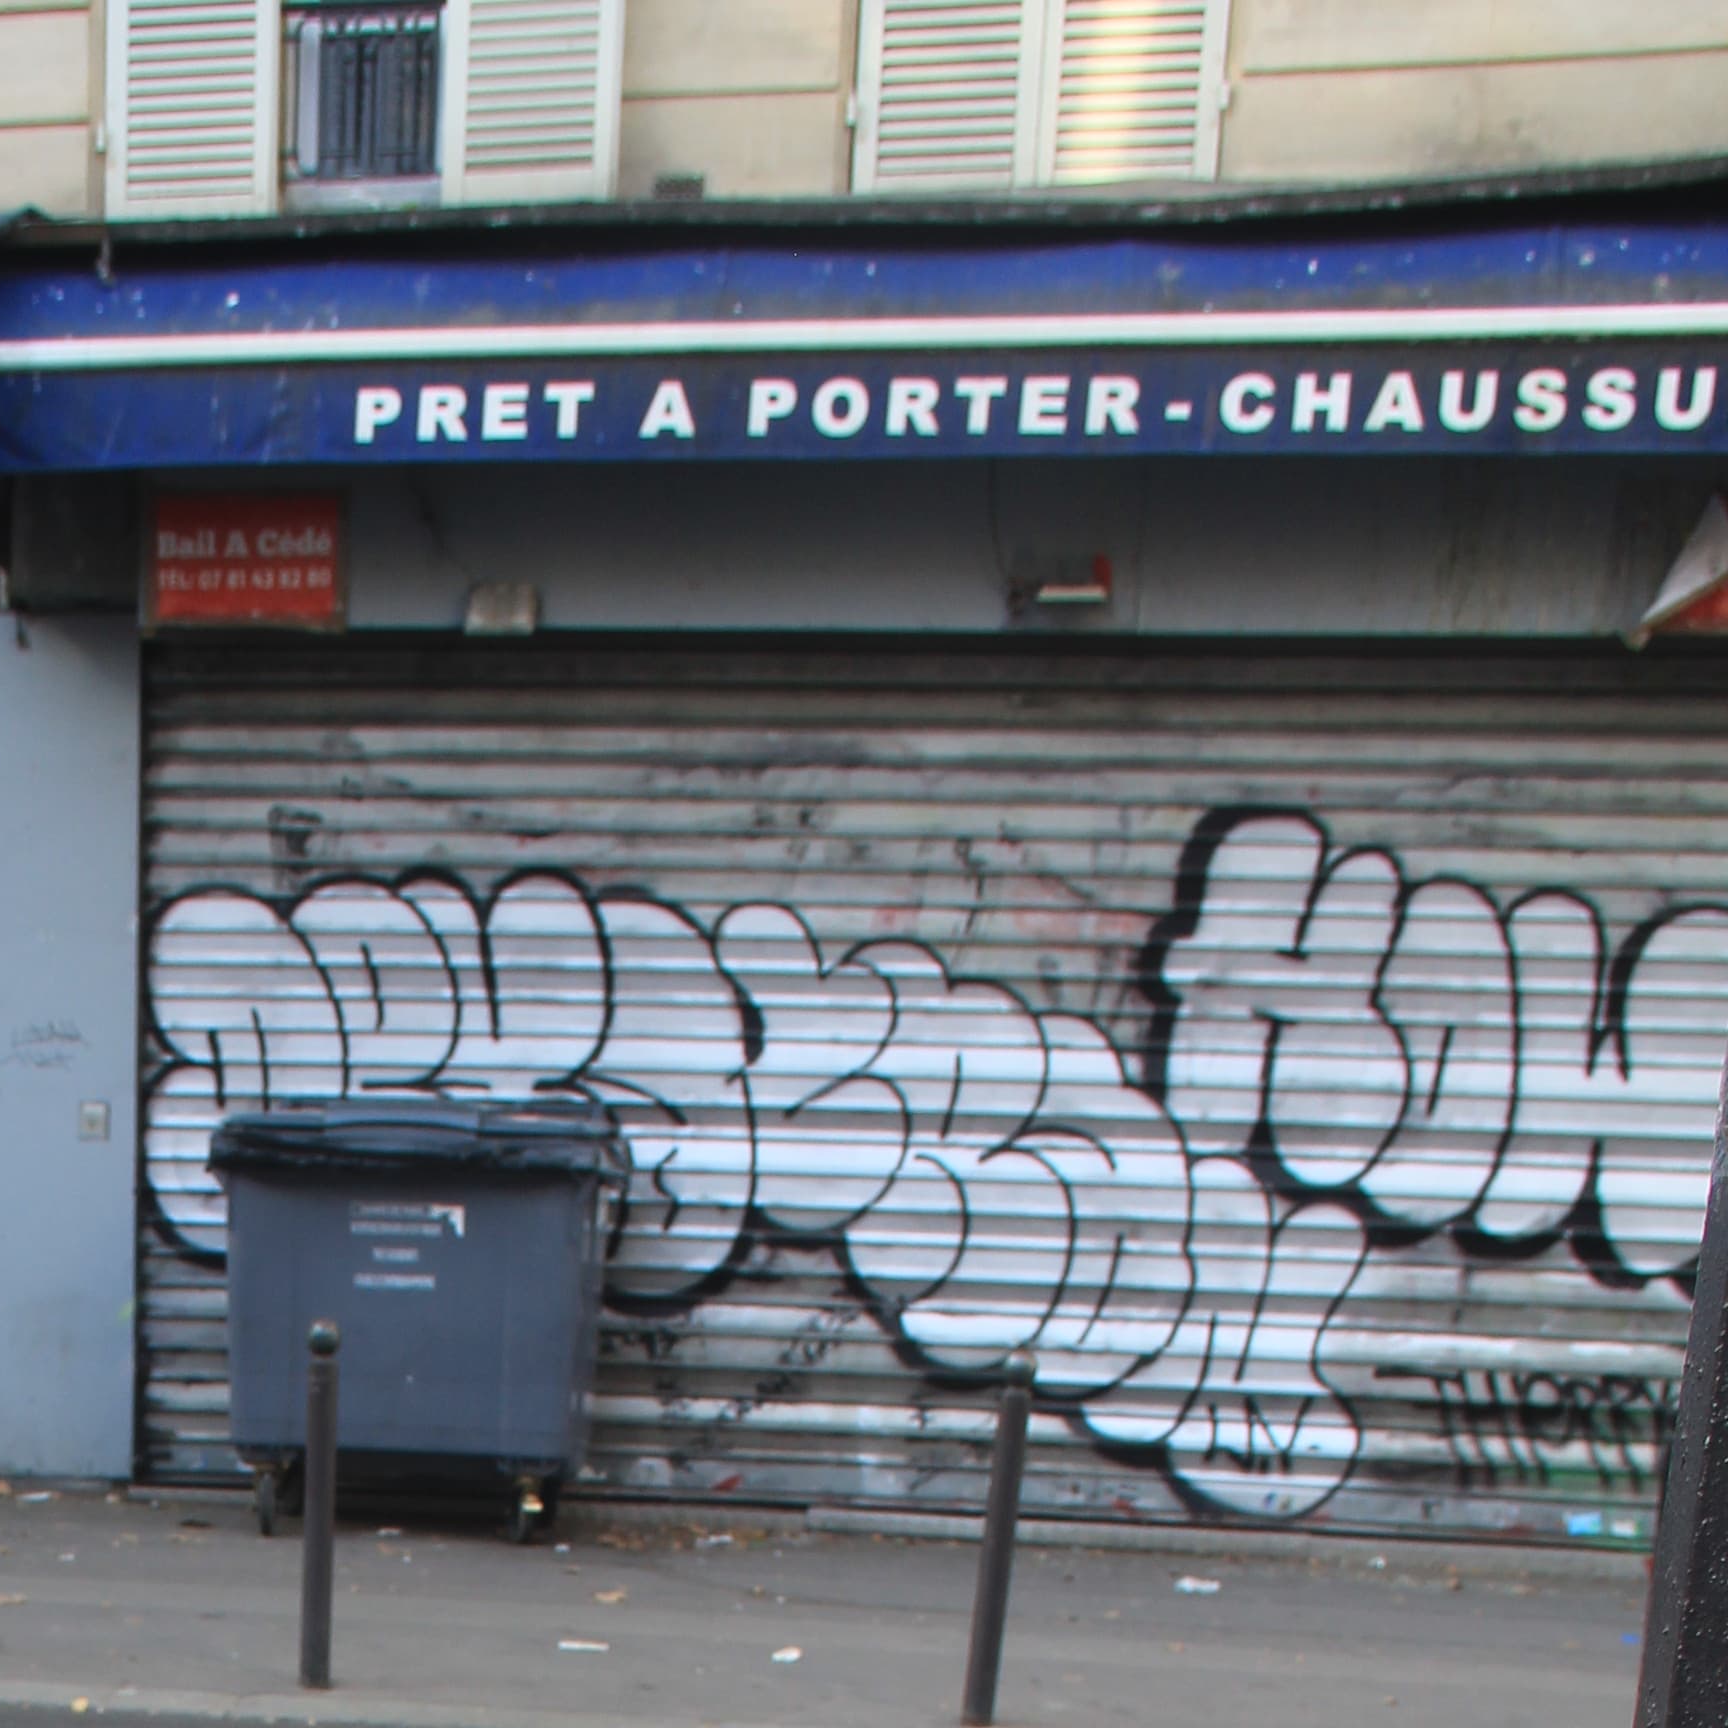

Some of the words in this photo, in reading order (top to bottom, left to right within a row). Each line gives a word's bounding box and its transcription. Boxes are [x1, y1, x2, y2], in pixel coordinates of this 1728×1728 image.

[353, 381, 595, 444] PRET
[638, 380, 696, 439] A
[158, 528, 216, 559] Bail
[225, 529, 249, 558] A
